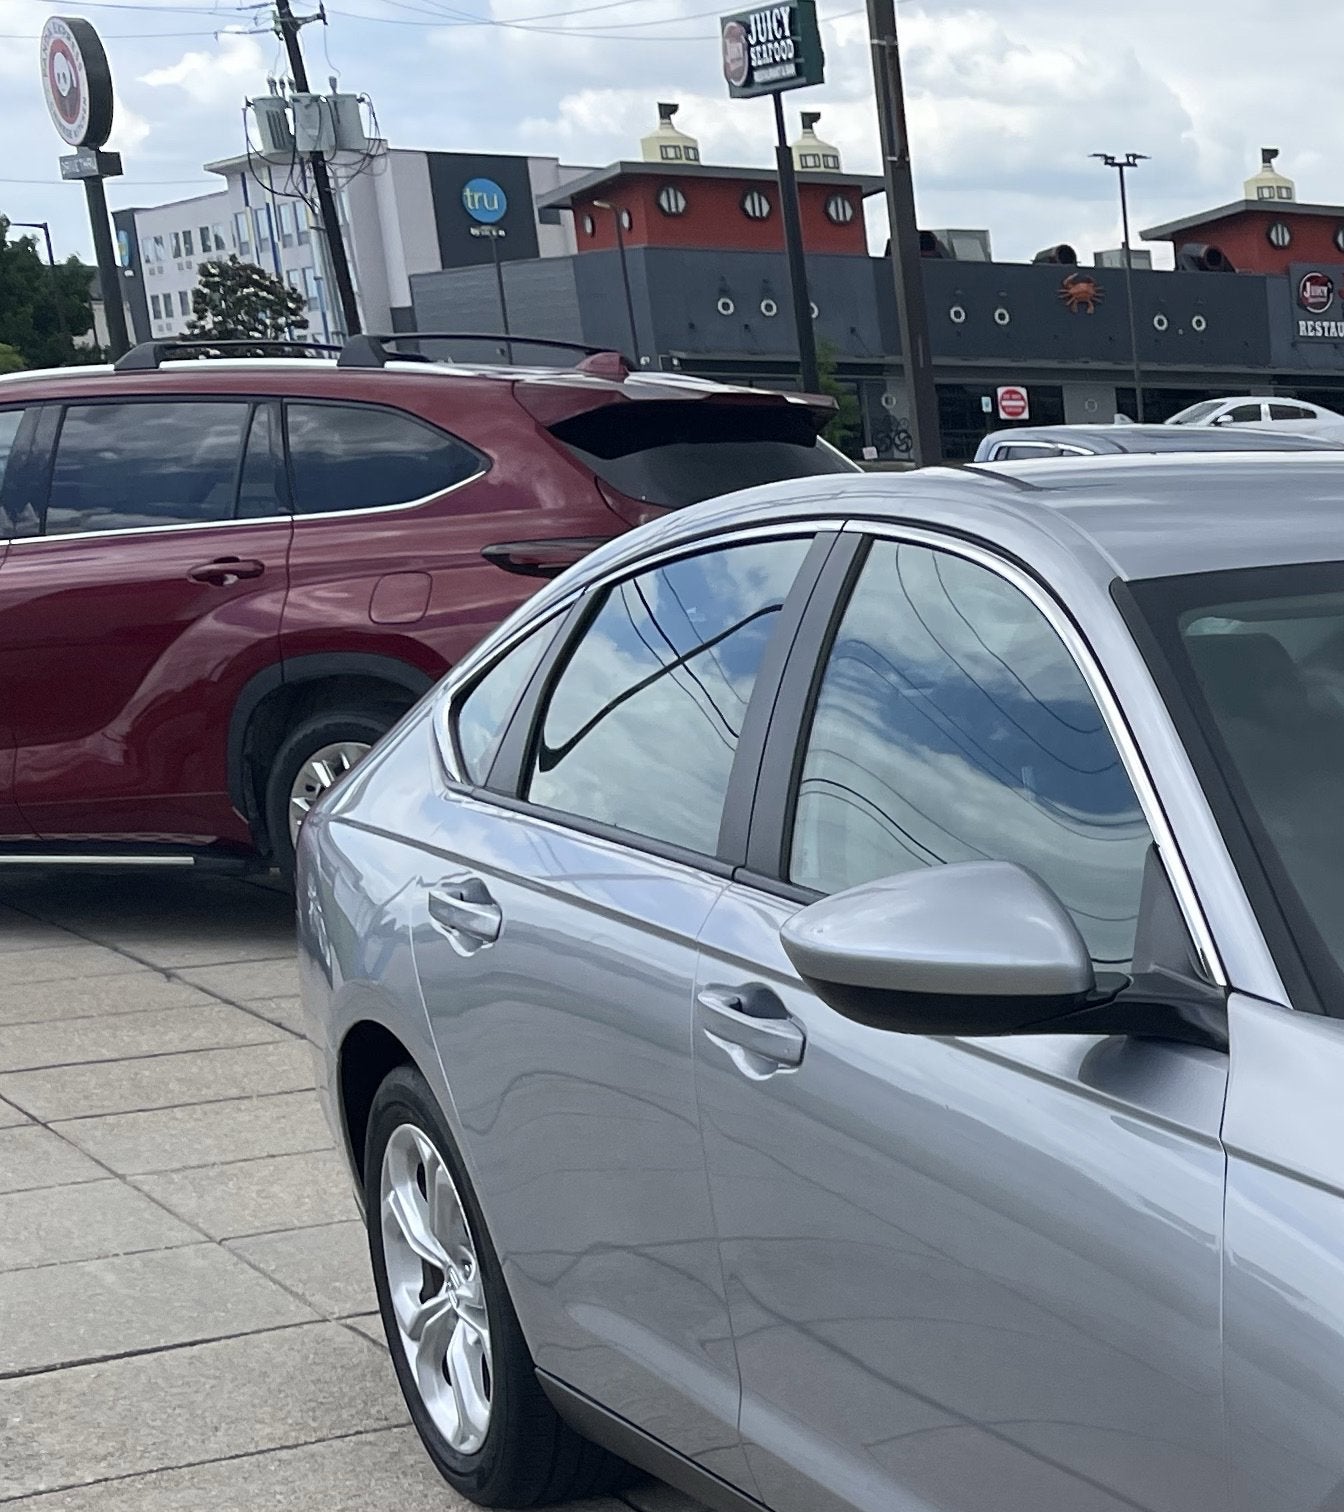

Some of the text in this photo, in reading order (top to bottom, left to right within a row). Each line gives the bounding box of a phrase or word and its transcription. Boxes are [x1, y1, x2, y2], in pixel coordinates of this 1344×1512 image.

[748, 6, 791, 45] JUICY
[750, 38, 795, 67] SEAFOOD
[463, 187, 499, 212] tru
